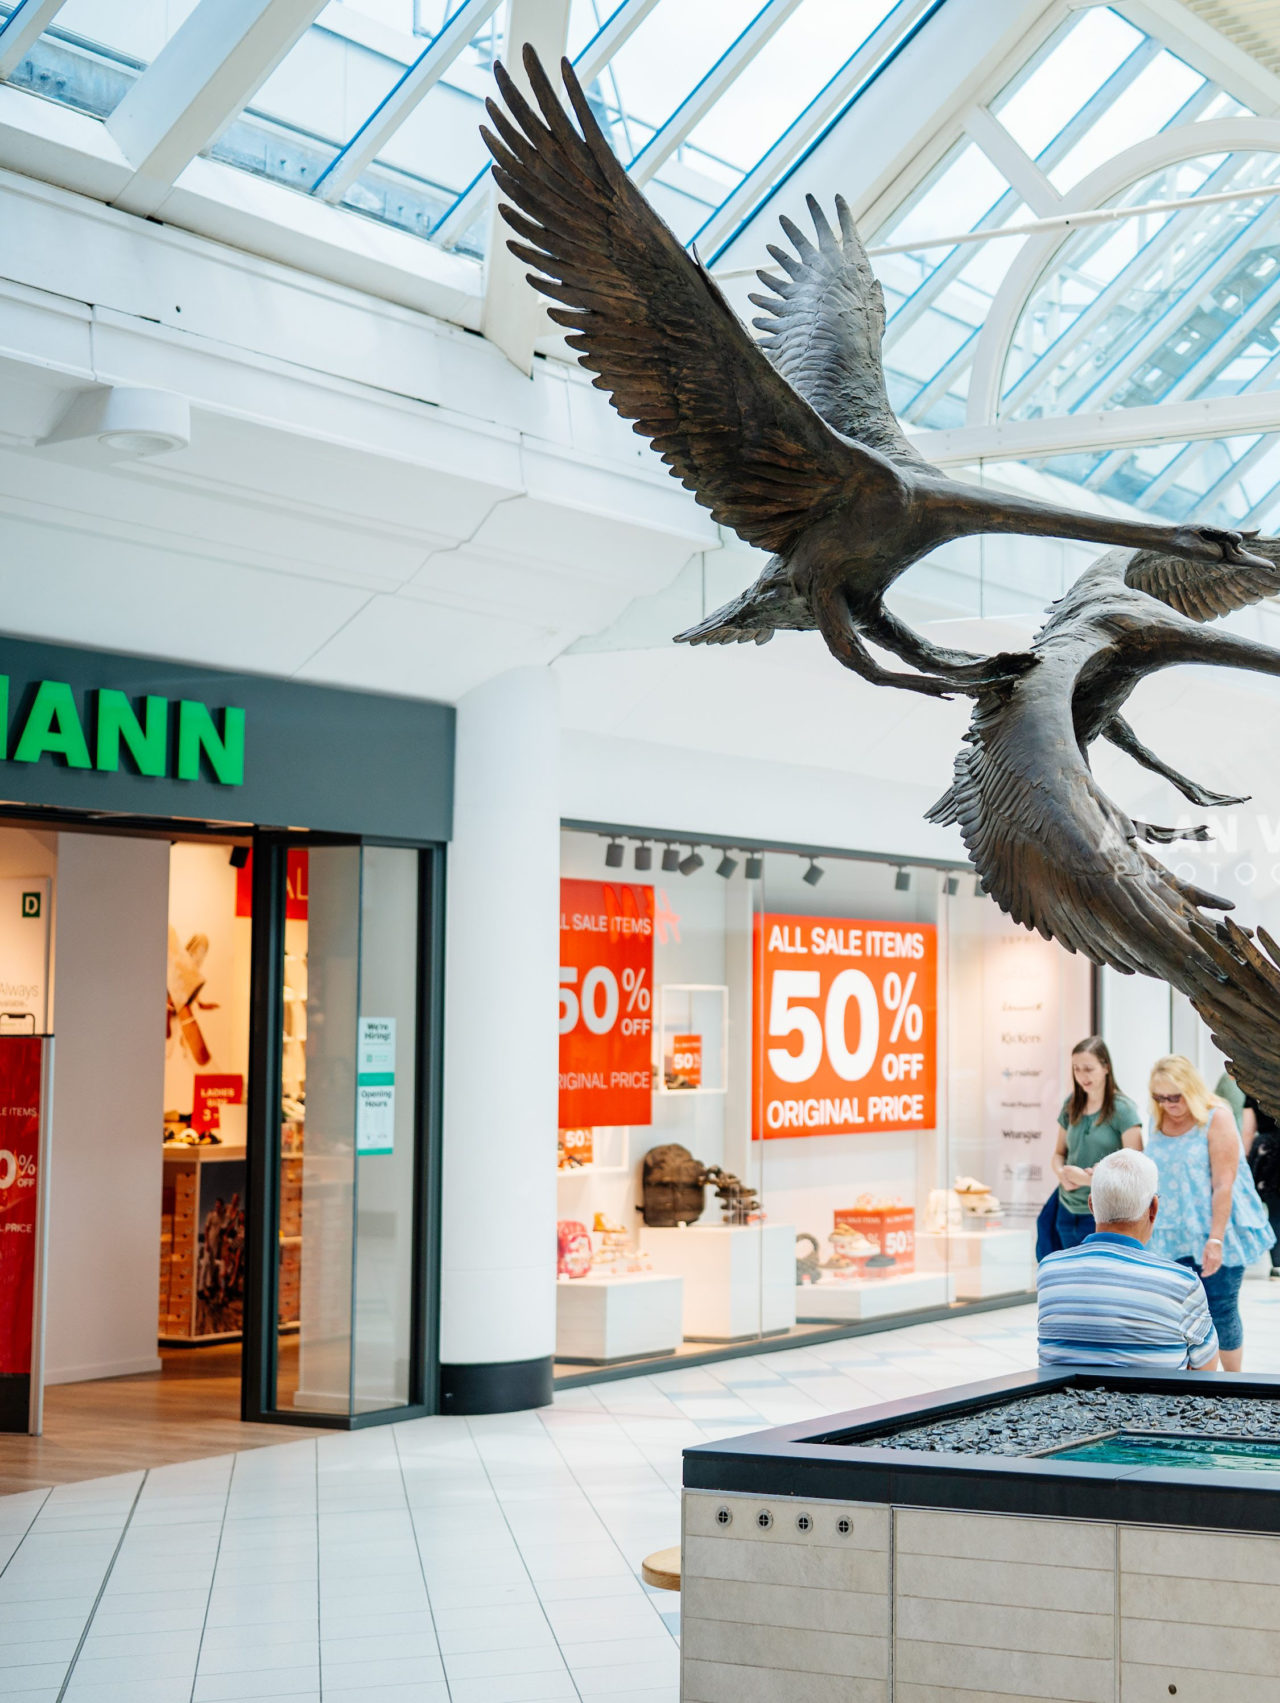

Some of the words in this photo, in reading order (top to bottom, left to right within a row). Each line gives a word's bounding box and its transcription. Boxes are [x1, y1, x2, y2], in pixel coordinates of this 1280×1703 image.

[0, 674, 246, 786] ANN
[573, 914, 608, 932] SALE
[611, 916, 652, 935] ITEMS
[768, 925, 808, 953] ALL
[811, 927, 863, 956] SALE
[866, 931, 924, 959] ITEMS
[621, 1018, 651, 1036] OFF
[768, 968, 924, 1083] 50%
[559, 1071, 608, 1090] RIGINAL
[611, 1071, 650, 1088] PRICE
[882, 1053, 924, 1082] OFF
[361, 1090, 392, 1099] Opening
[767, 1100, 865, 1129] ORIGINAL
[868, 1094, 924, 1122] PRICE
